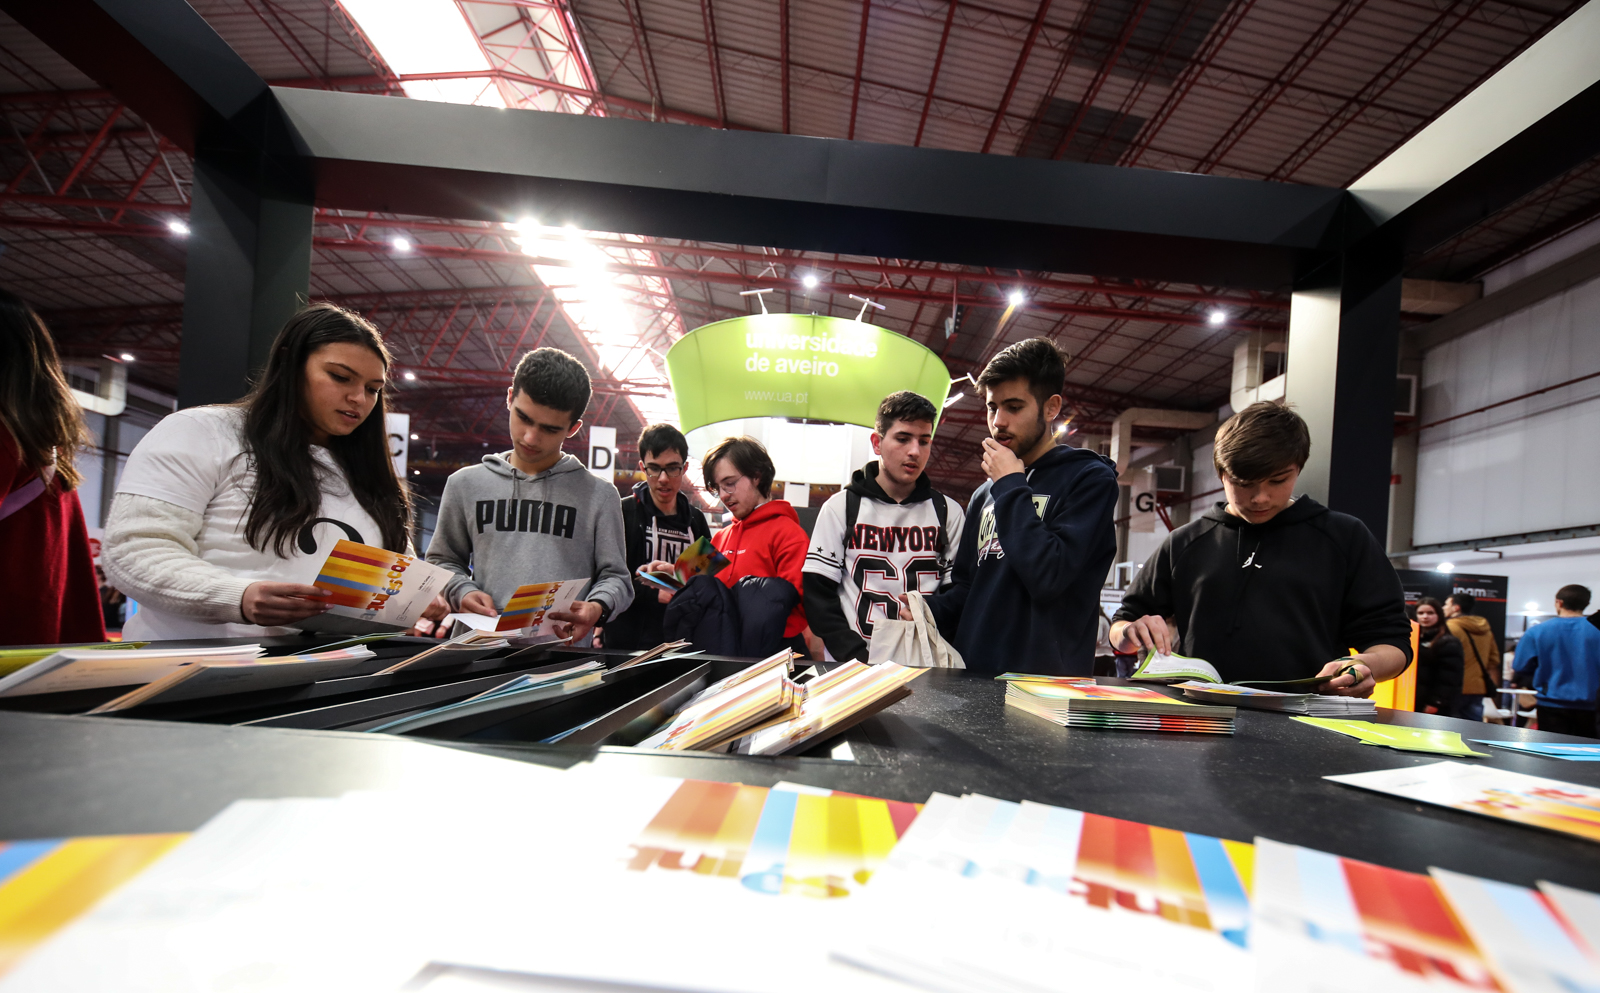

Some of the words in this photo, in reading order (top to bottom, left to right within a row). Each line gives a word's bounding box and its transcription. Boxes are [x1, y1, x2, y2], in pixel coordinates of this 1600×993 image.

[745, 332, 878, 358] universidade
[745, 352, 770, 372] de
[775, 355, 840, 377] aveiro
[744, 390, 808, 405] www.ua.pt
[388, 433, 404, 457] C
[591, 445, 612, 470] D
[1135, 492, 1155, 513] G
[475, 498, 577, 540] PUMA
